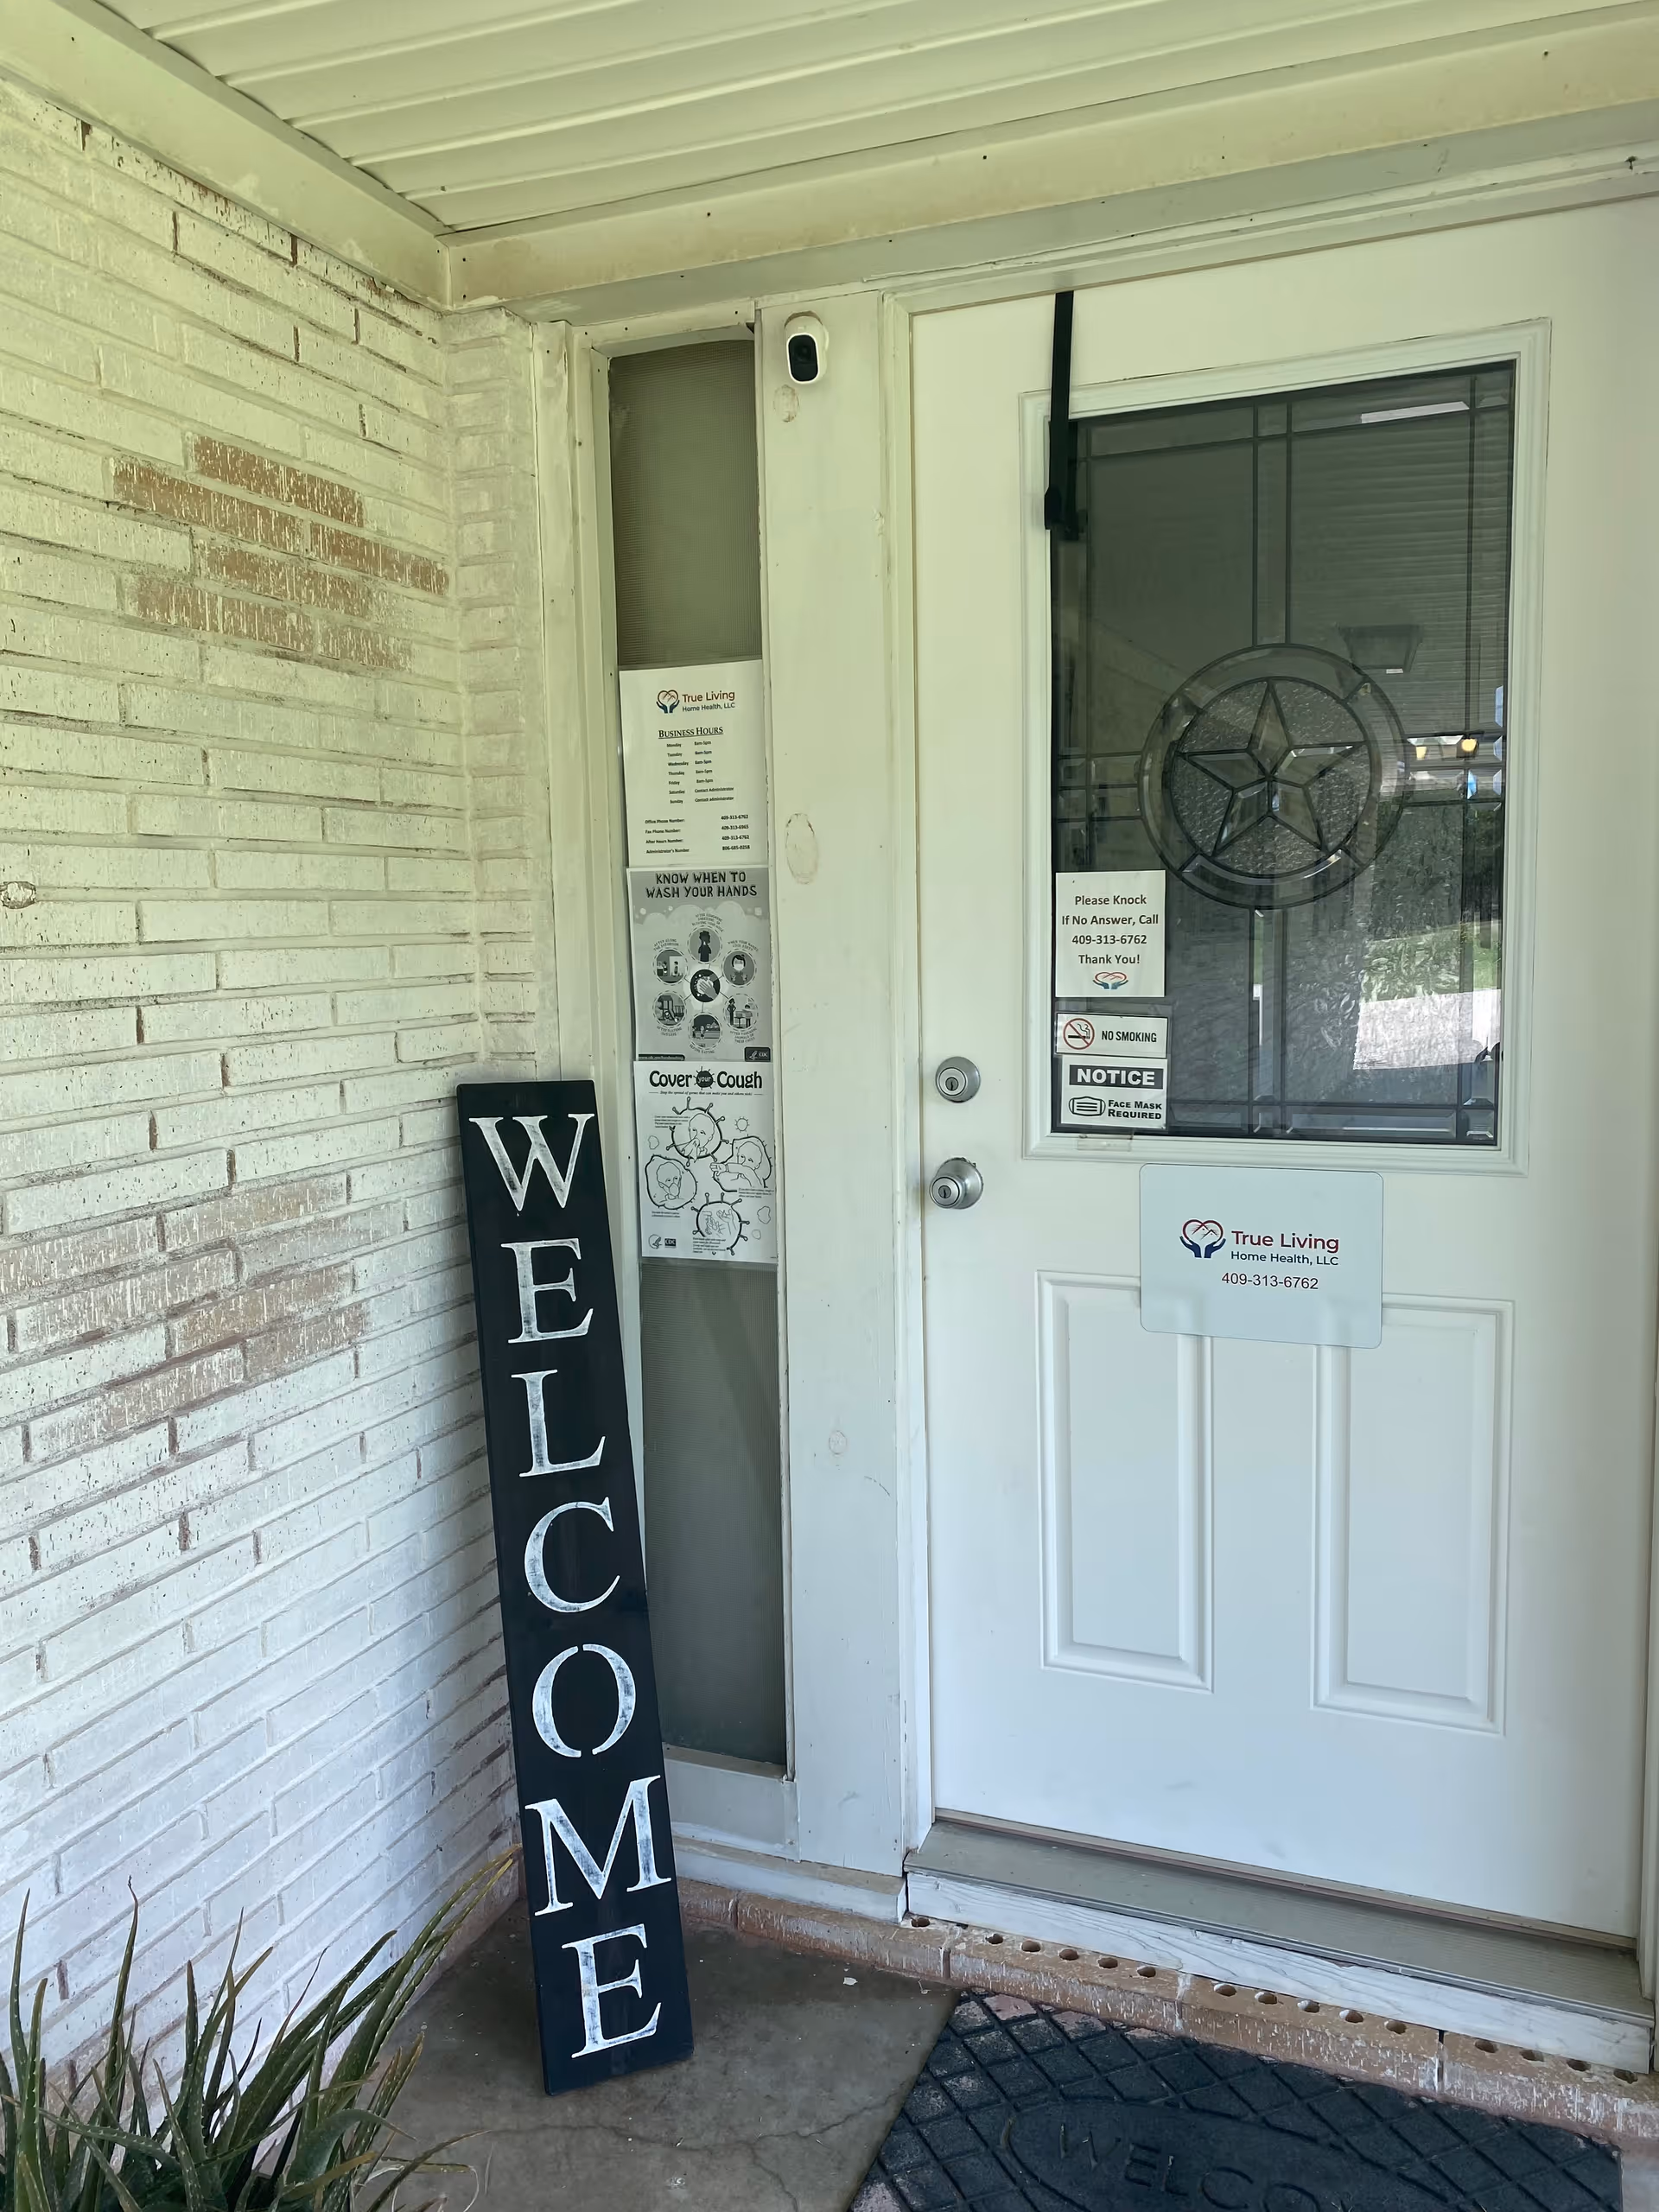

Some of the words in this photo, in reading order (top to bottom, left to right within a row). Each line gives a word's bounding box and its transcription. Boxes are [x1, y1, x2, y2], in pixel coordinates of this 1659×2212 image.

[682, 694, 703, 702] True
[706, 690, 735, 701] Living
[658, 728, 695, 738] BUSINESS
[696, 727, 724, 735] HOURS
[656, 873, 689, 884] KNOW
[693, 872, 727, 883] WHEN
[730, 871, 747, 882] TO
[645, 887, 680, 899] WASH
[683, 886, 714, 898] YOUR
[717, 885, 758, 897] HANDS
[1075, 895, 1110, 905] Please
[1113, 894, 1147, 905] Knock
[1062, 915, 1070, 925] If
[1072, 916, 1087, 925] No
[1090, 915, 1135, 926] Answer,
[1139, 914, 1159, 925] Call
[1072, 935, 1147, 944] 409-313-6762
[1078, 954, 1112, 964] Thank
[1115, 954, 1141, 964] You!
[1102, 1031, 1114, 1040] NO
[1116, 1031, 1157, 1042] SMOKING
[649, 1070, 693, 1087] Cover
[717, 1071, 763, 1089] Cough
[1077, 1068, 1155, 1086] NOTICE
[1108, 1100, 1131, 1108] FACE
[1134, 1101, 1162, 1109] MASK
[1108, 1109, 1162, 1120] REQUIRED
[1231, 1230, 1274, 1247] True
[1280, 1232, 1339, 1254] Living
[1231, 1251, 1267, 1262] Home
[1270, 1253, 1313, 1266] Health,
[1316, 1255, 1339, 1266] LLC
[1221, 1272, 1319, 1290] 409-313-6762
[467, 1113, 671, 2059] WELCOME
